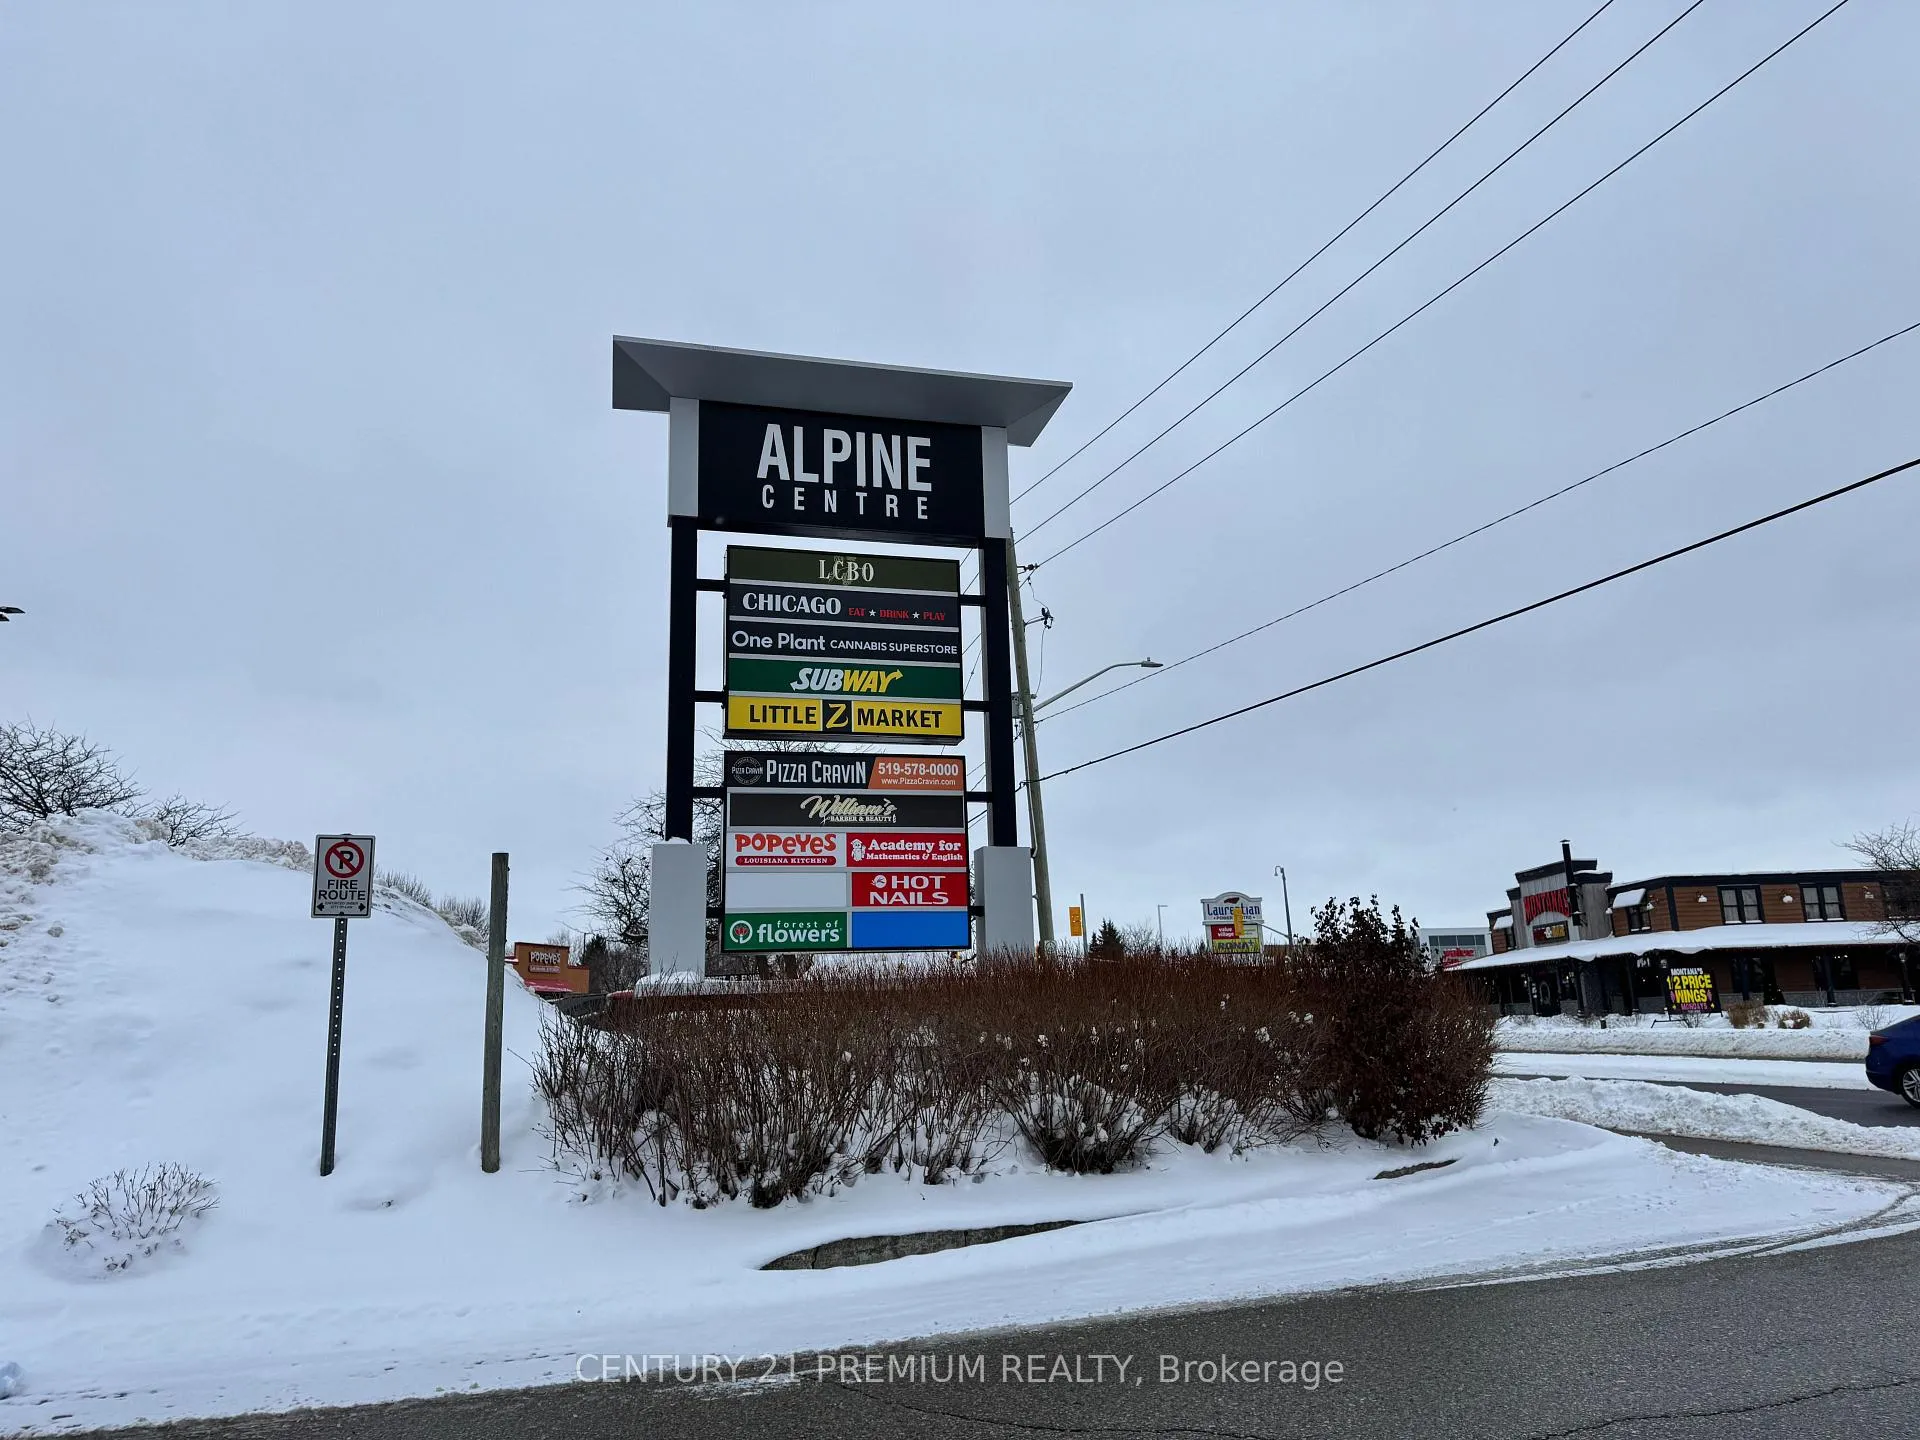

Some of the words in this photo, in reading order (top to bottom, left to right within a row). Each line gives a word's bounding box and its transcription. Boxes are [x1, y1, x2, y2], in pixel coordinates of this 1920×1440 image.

[757, 423, 932, 491] ALPINE
[762, 484, 928, 519] CENTRE
[818, 559, 874, 582] LCBO
[742, 592, 841, 615] CHICAGO
[848, 607, 866, 617] EAT
[880, 609, 909, 619] DRINK
[923, 611, 946, 621] PLAY
[732, 630, 773, 648] One
[778, 632, 826, 651] Plant
[830, 639, 887, 652] CANNABIS
[888, 642, 958, 655] SUPERSTORE
[790, 668, 904, 693] SUBWAY
[749, 704, 817, 725] LITTLE
[826, 703, 849, 729] Z
[857, 708, 943, 728] MARKET
[766, 759, 807, 783] PIZZA
[878, 762, 959, 776] 519-578-0000
[881, 777, 956, 786] www.PizzaCravin.com
[800, 795, 897, 818] William's
[868, 839, 935, 853] Academy
[938, 840, 961, 851] for
[931, 853, 963, 861] English
[327, 880, 358, 890] FIRE
[891, 875, 946, 889] HOT
[318, 890, 366, 901] ROUTE
[869, 891, 949, 905] NAILS
[777, 920, 818, 929] forest
[825, 919, 839, 928] of
[757, 923, 840, 943] flowers
[1681, 974, 1713, 990] PRICE
[1674, 988, 1707, 1004] WINGS
